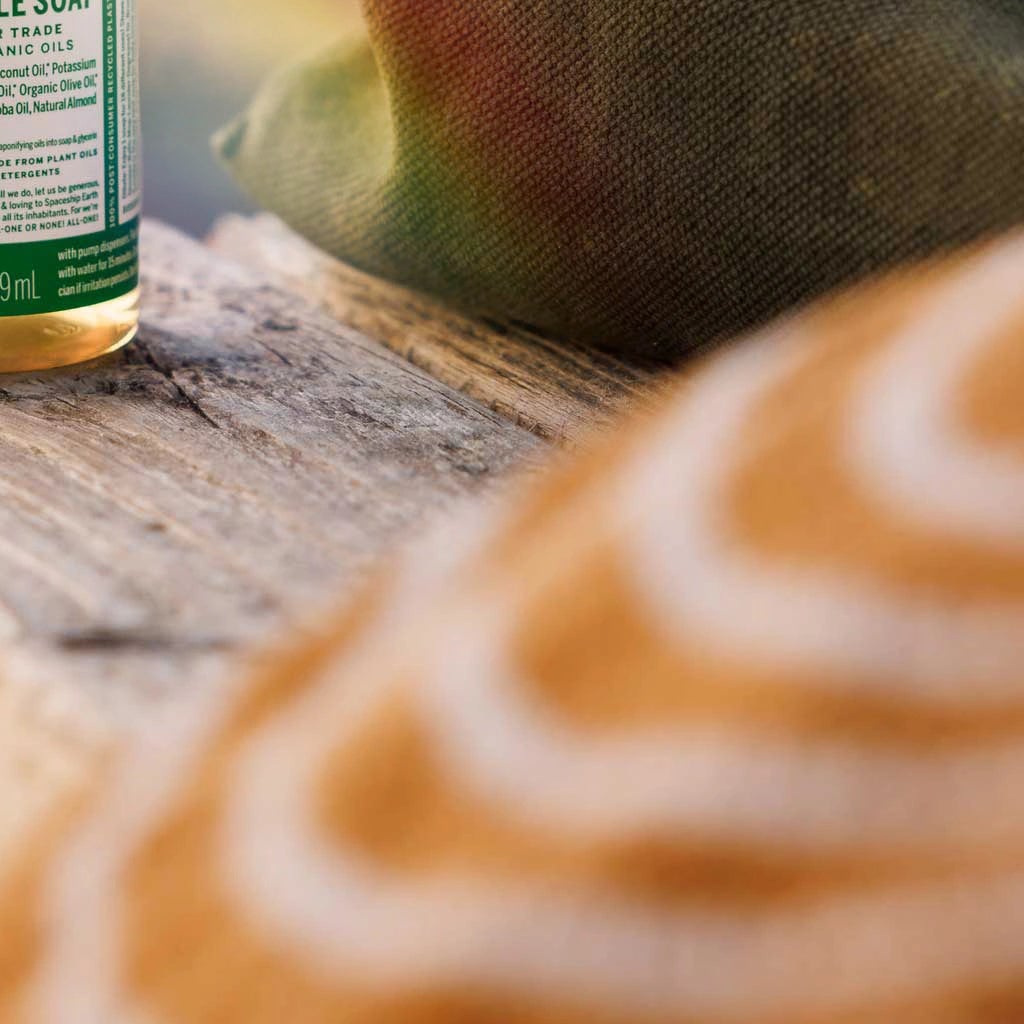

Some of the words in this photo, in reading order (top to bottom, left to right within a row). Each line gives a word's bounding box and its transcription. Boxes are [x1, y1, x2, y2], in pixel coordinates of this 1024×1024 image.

[10, 24, 62, 38] TRADE
[41, 40, 74, 53] OILS
[52, 58, 96, 75] Potassium
[19, 81, 57, 97] Organic
[60, 79, 82, 92] Olive
[16, 102, 32, 115] Oil,
[33, 98, 66, 113] Natural
[67, 93, 97, 109] Almond
[34, 139, 45, 148] oils
[46, 137, 57, 147] into
[58, 136, 72, 146] soap
[15, 157, 43, 166] FROM
[47, 152, 77, 164] PLANT
[79, 148, 98, 159] OILS
[35, 187, 45, 195] let
[47, 187, 56, 195] us
[58, 185, 67, 193] be
[1, 201, 7, 210] &
[9, 201, 33, 211] loving
[35, 199, 43, 207] to
[44, 194, 81, 208] Spaceship
[82, 191, 98, 202] Earth
[2, 213, 12, 221] all
[13, 212, 24, 221] its
[25, 209, 69, 220] inhabitants.
[71, 205, 81, 215] For
[25, 223, 37, 232] OR
[39, 220, 65, 230] NONE!
[67, 214, 99, 227] ALL-ONE!
[58, 246, 76, 261] with
[78, 244, 99, 260] pump
[58, 265, 76, 279] with
[77, 263, 97, 276] water
[98, 258, 107, 271] for
[15, 269, 41, 301] mL
[58, 284, 75, 297] cian
